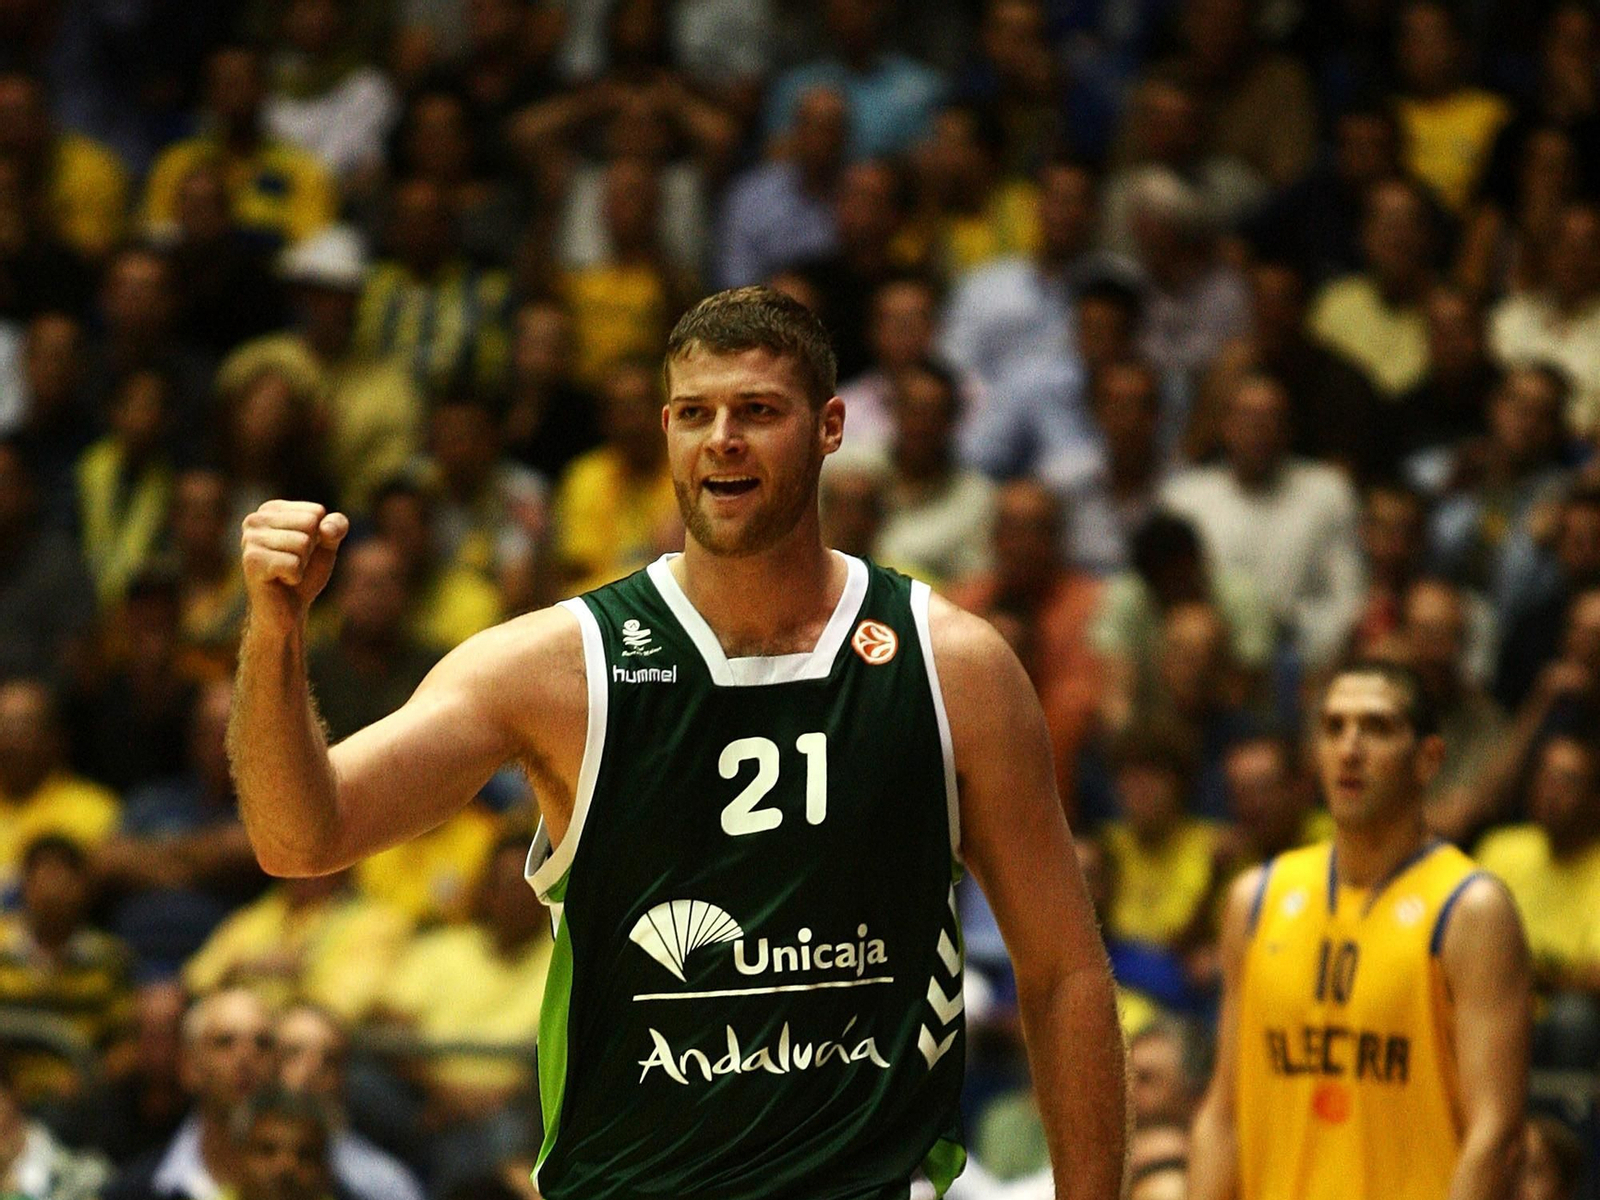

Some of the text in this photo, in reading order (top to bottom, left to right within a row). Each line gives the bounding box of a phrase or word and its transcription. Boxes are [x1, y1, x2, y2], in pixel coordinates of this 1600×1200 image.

[612, 664, 677, 684] hummel
[717, 732, 828, 837] 21
[733, 922, 889, 978] Unicaja
[1313, 937, 1360, 1006] 10
